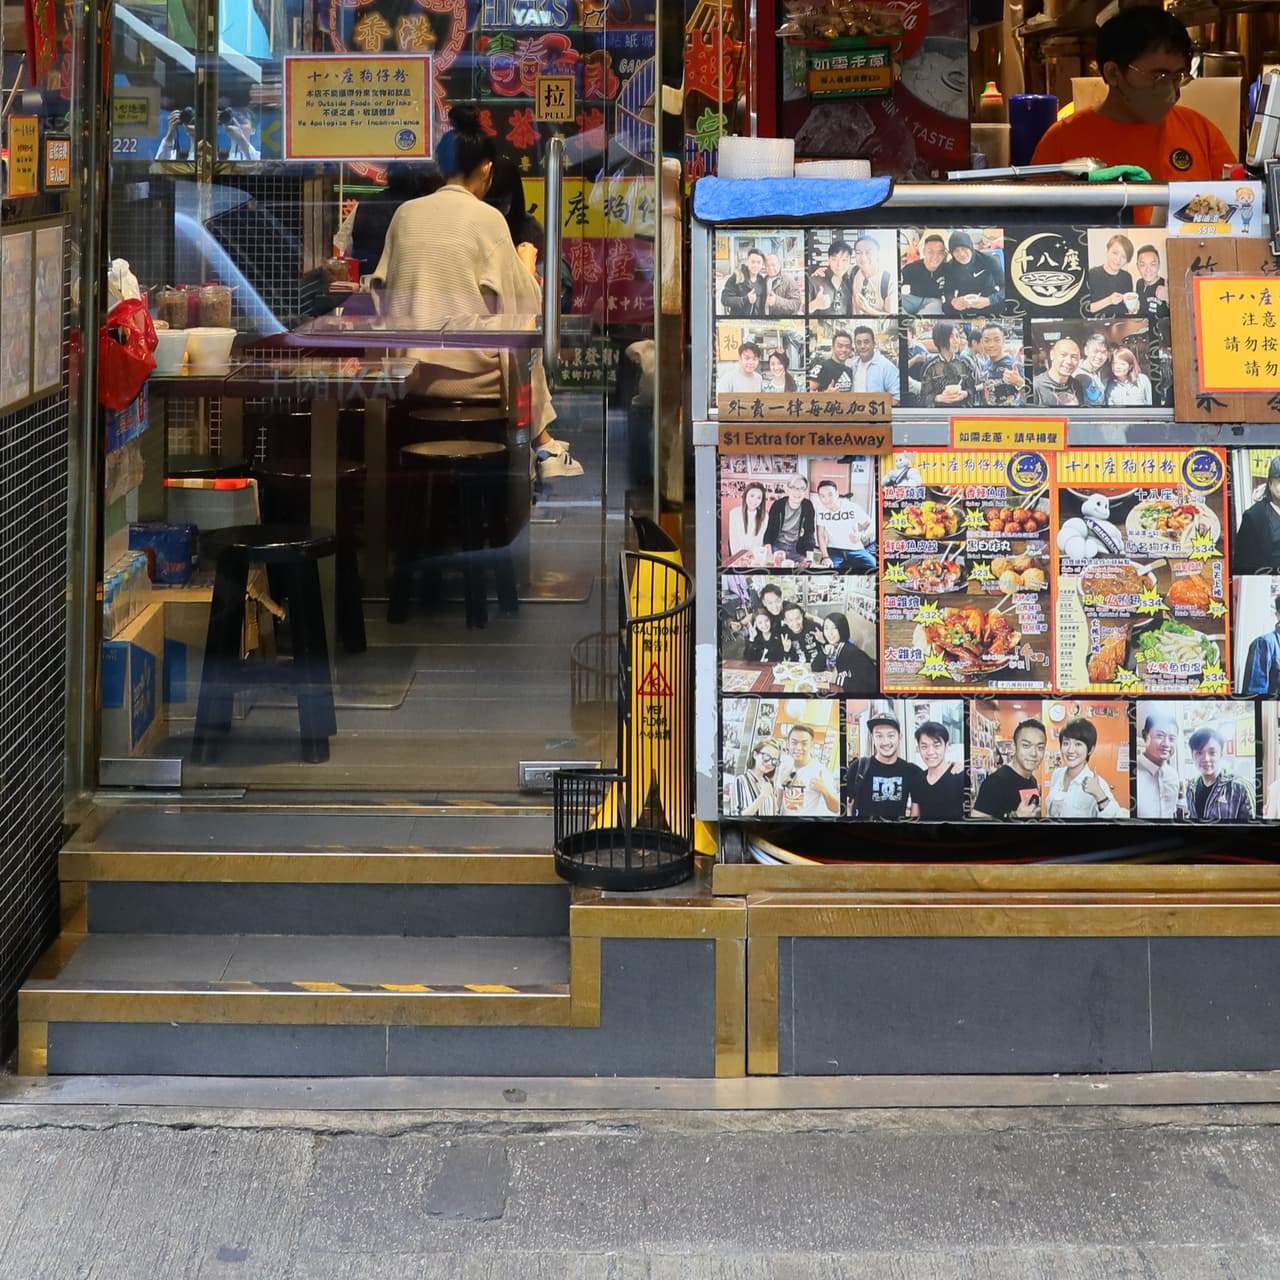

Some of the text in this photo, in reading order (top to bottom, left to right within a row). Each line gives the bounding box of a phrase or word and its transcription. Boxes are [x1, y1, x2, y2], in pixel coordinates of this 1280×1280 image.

[307, 67, 409, 85] 十八座狗仔粉
[544, 83, 566, 108] 拉
[1016, 247, 1083, 271] 十八座
[723, 431, 886, 449] $1 Extra for TakeAway
[917, 457, 1007, 473] 十八座狗仔粉
[1064, 457, 1177, 475] 十八座狗仔粉
